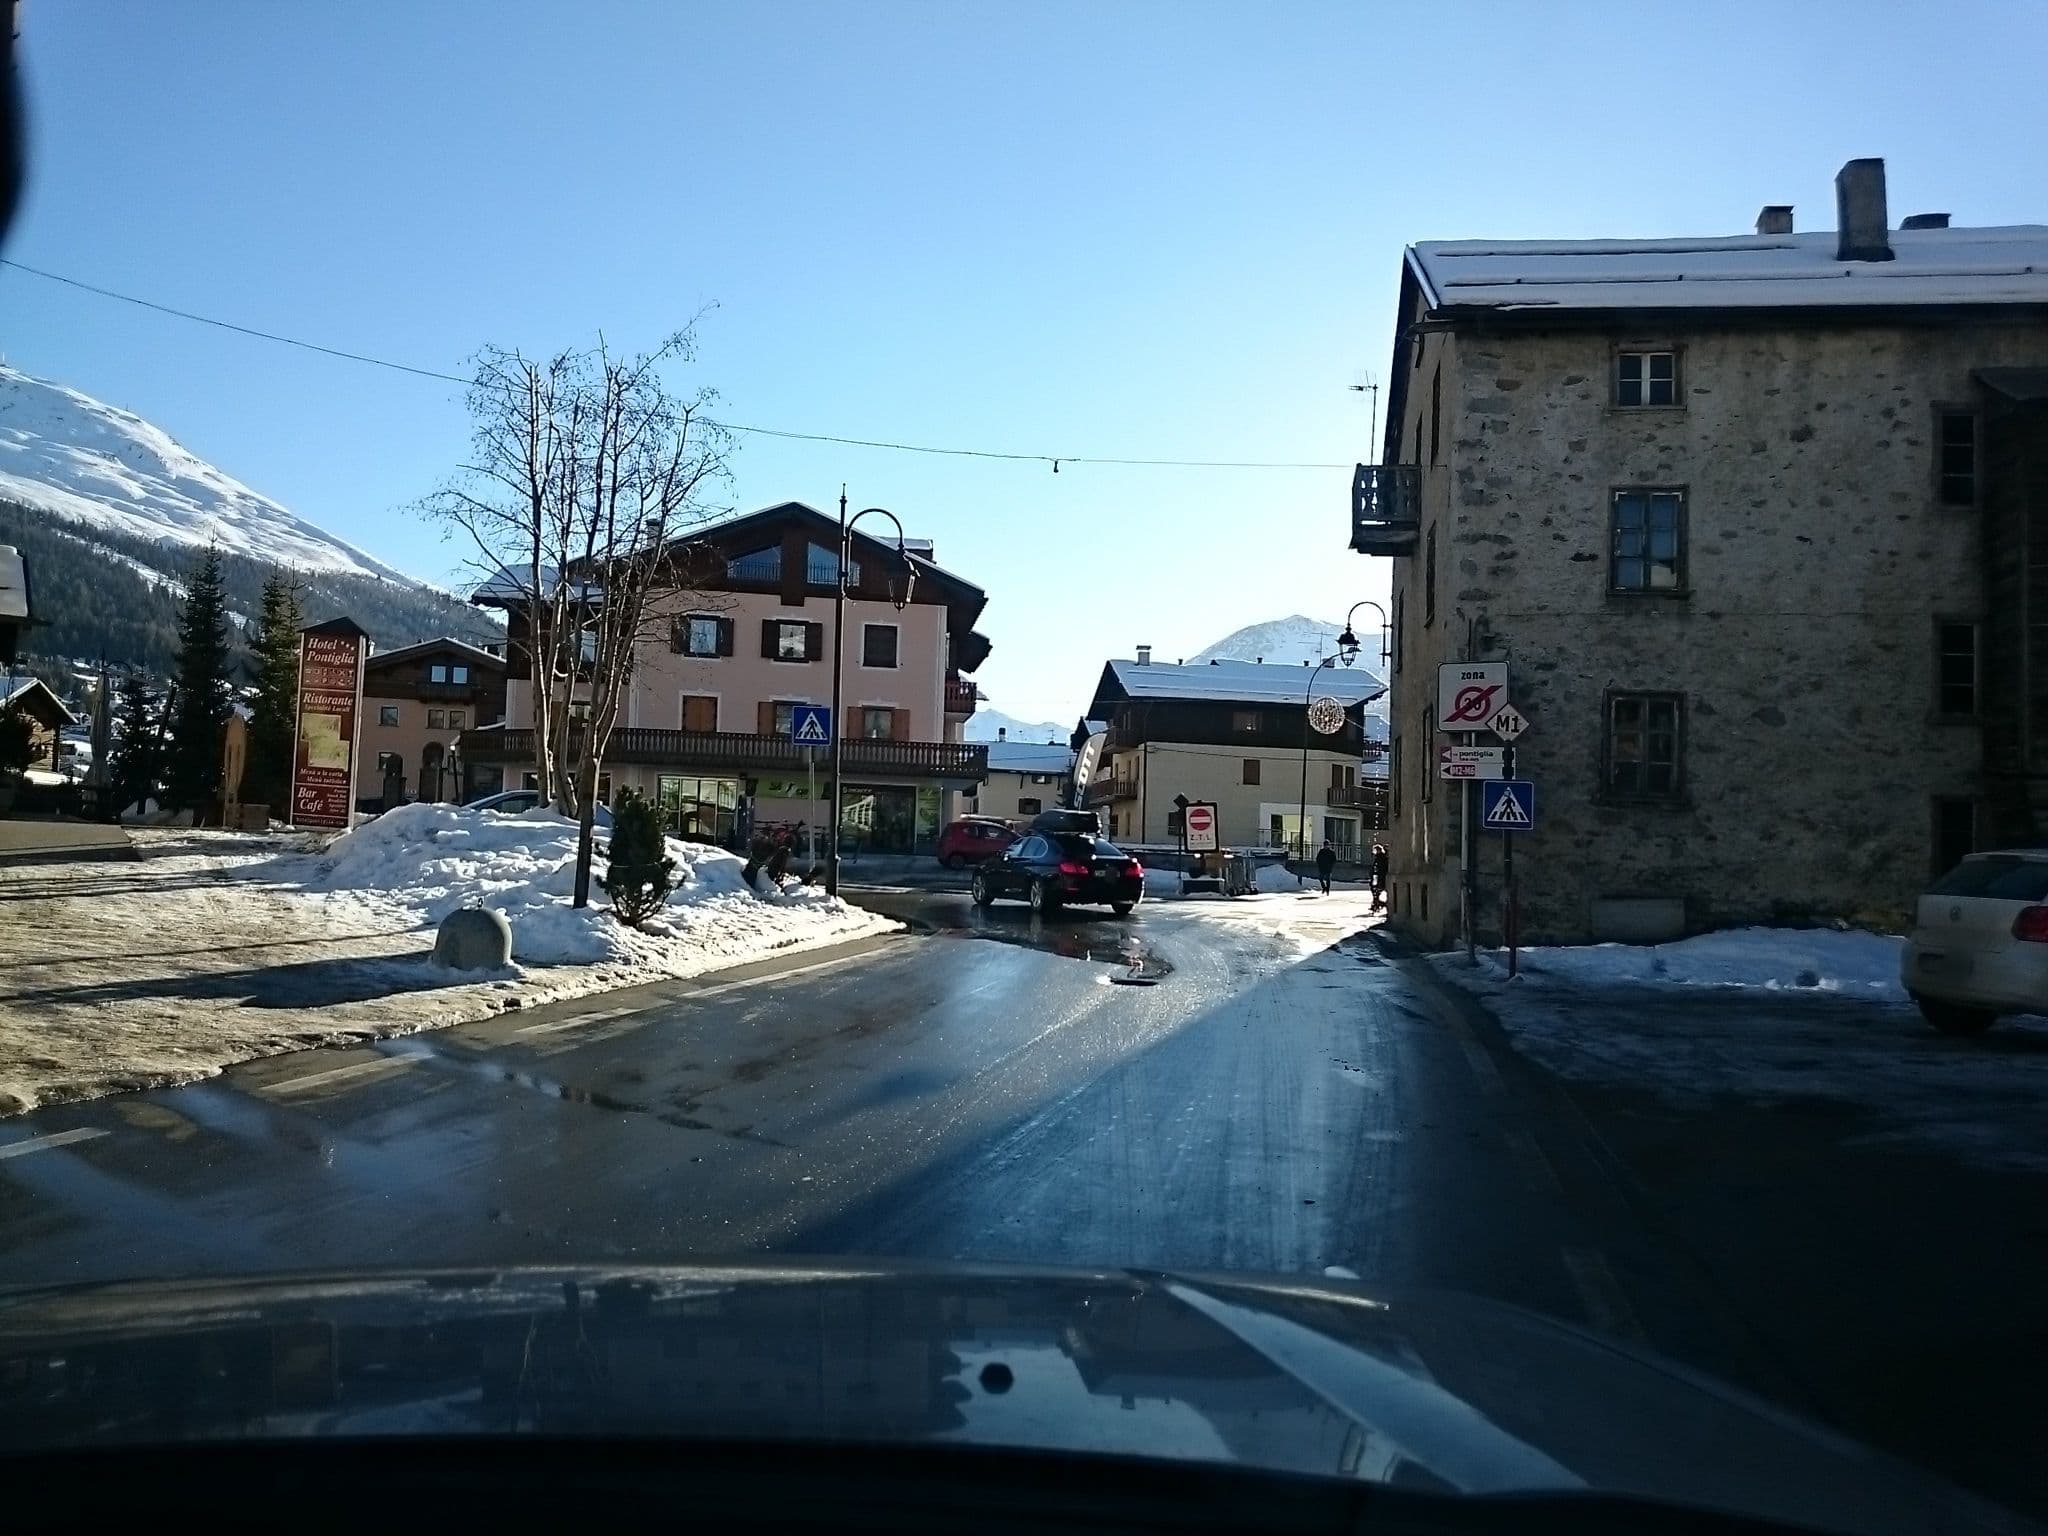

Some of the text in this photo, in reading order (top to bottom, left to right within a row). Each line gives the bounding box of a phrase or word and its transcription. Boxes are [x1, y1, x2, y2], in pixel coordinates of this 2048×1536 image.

[308, 638, 338, 649] Hotel
[307, 651, 355, 665] Pontiglia
[1461, 671, 1485, 680] zona
[303, 693, 353, 705] Ristorante
[1496, 715, 1520, 733] M1
[1074, 741, 1095, 810] SCOTT
[298, 787, 317, 798] Bar
[300, 798, 323, 812] Café
